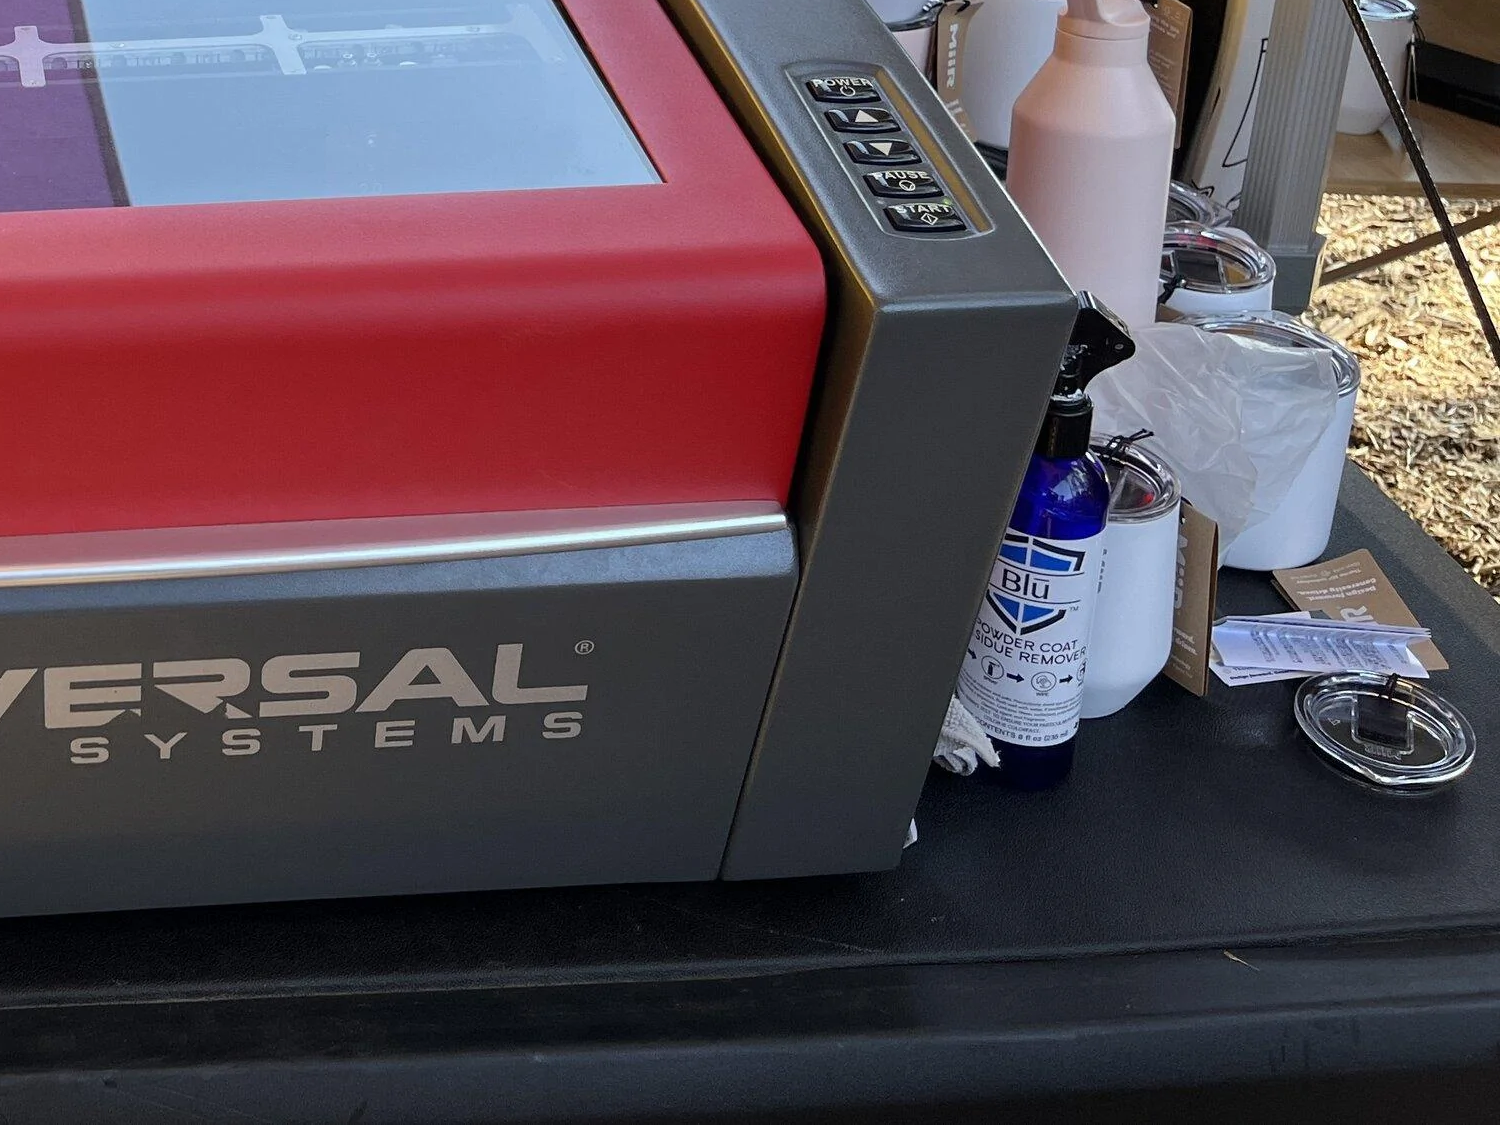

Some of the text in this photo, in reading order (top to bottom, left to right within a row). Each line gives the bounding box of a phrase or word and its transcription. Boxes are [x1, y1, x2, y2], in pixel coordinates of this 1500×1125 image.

[946, 23, 960, 88] MiiR
[812, 77, 874, 88] POWER
[869, 170, 928, 179] PAUSE
[894, 203, 953, 214] START
[975, 618, 1078, 653] POWDER COAT
[975, 629, 1087, 665] SIDUE REMOVER
[69, 711, 586, 766] SYSTEMS
